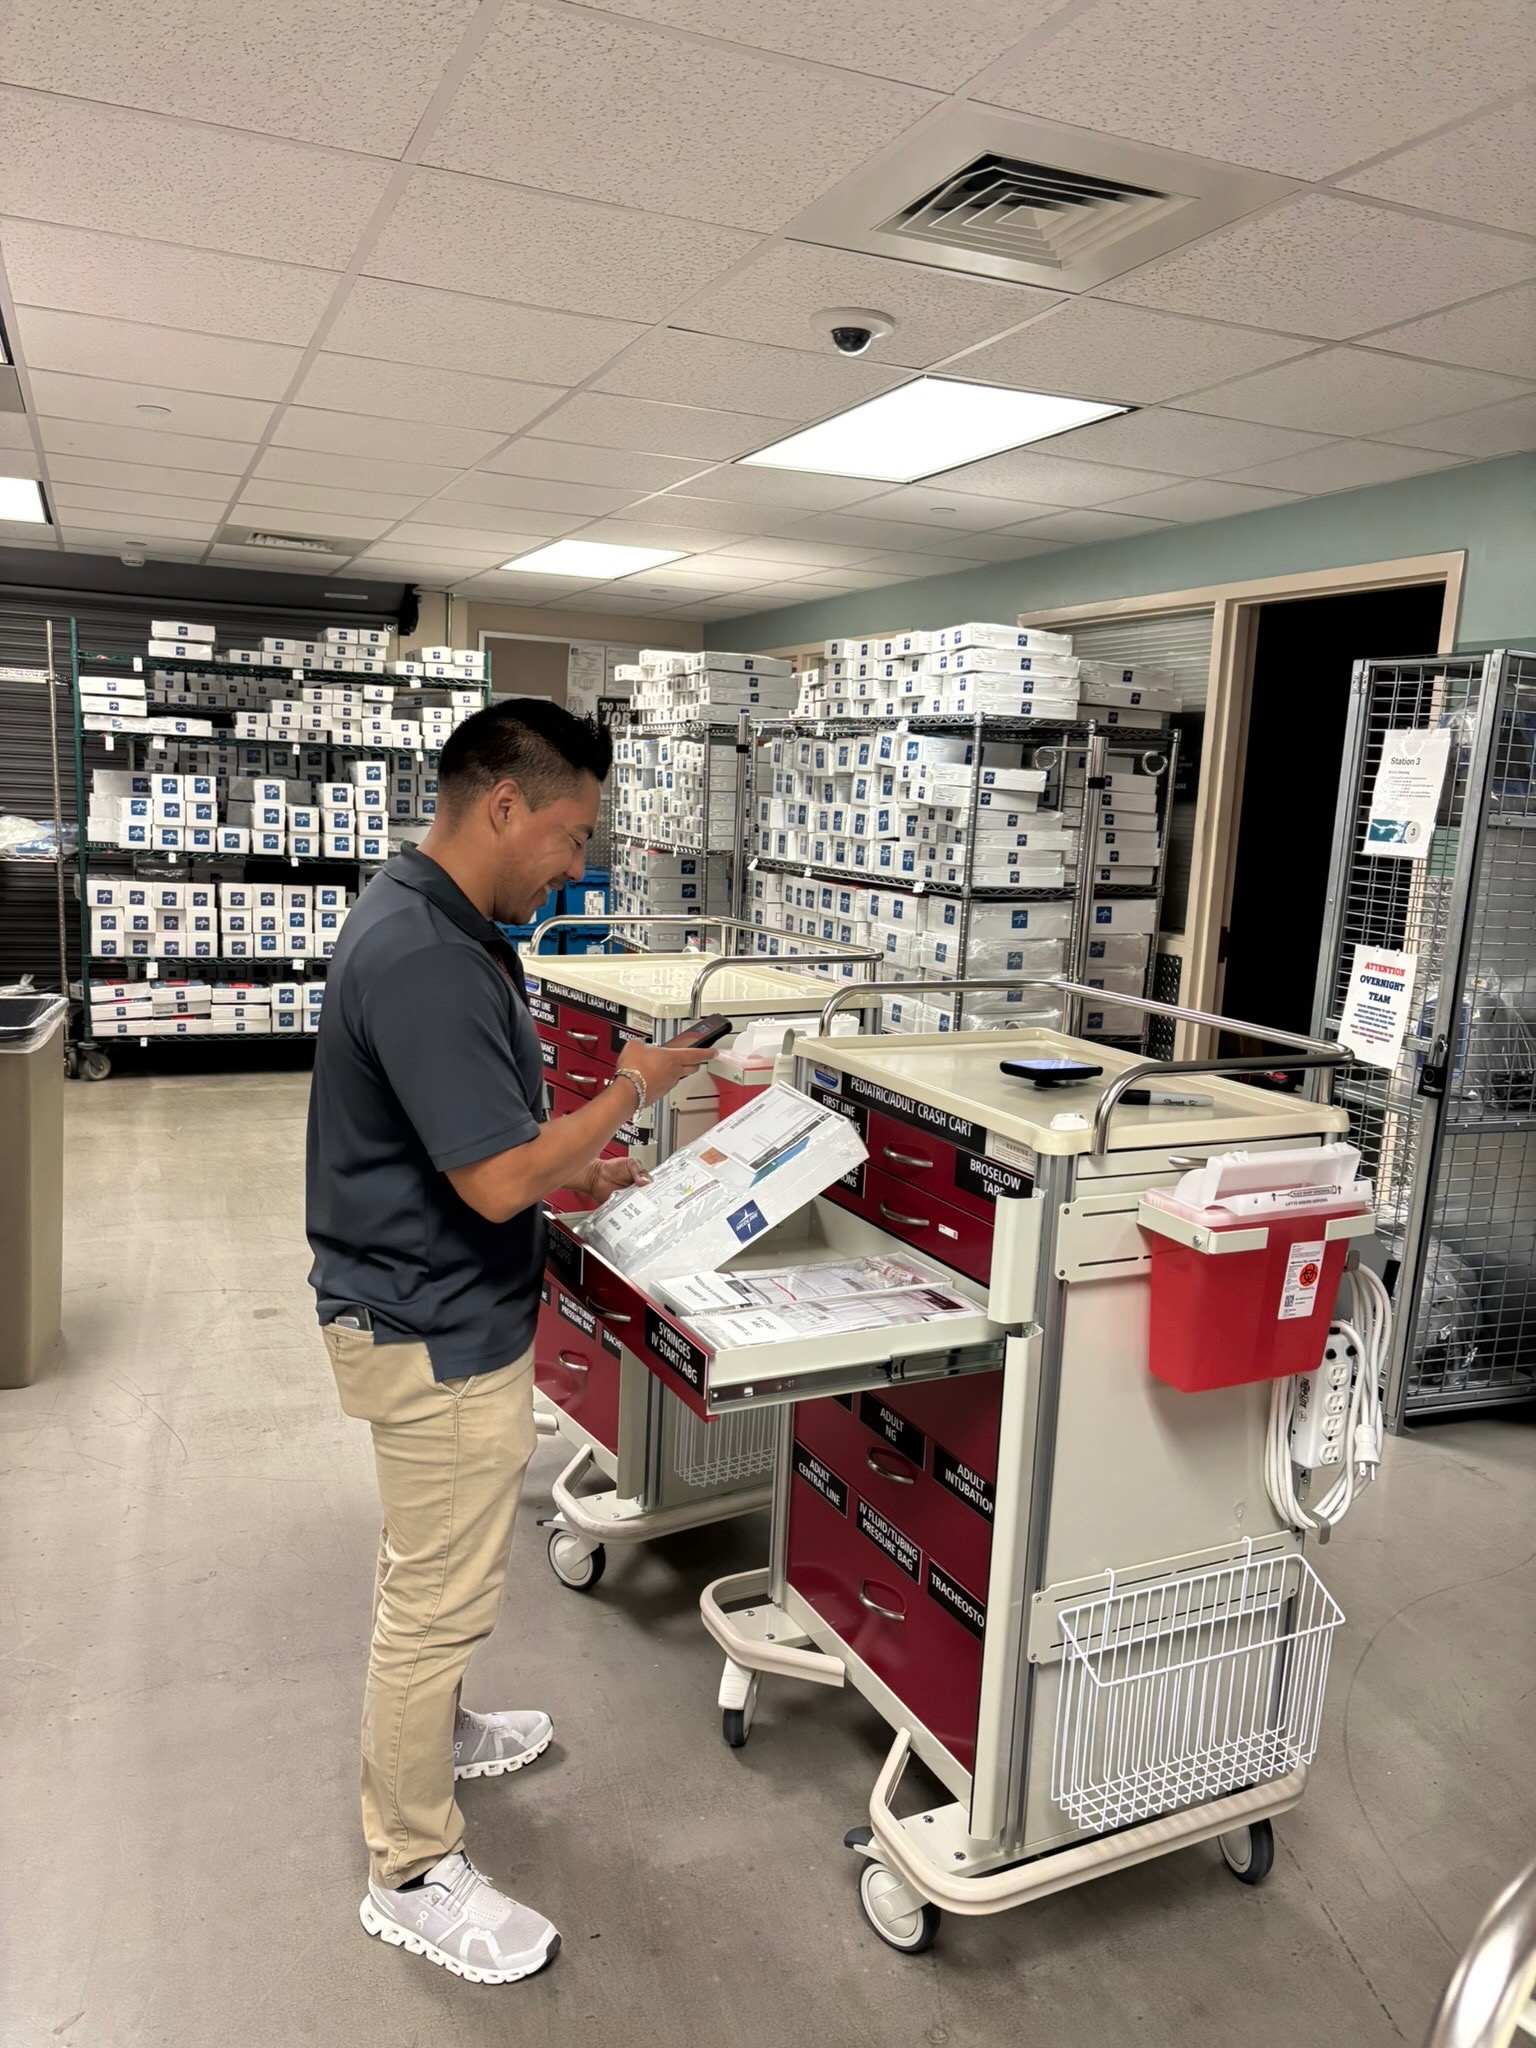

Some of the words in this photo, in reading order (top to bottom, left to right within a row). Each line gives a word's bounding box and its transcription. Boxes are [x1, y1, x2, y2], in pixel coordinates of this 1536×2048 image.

[616, 702, 633, 712] YOU
[1390, 756, 1415, 766] Station
[1416, 757, 1421, 766] 3
[1411, 828, 1416, 836] 3
[1364, 962, 1406, 977] ATTENTION
[1360, 974, 1406, 992] OVERNIGHT
[541, 1001, 551, 1012] LINE
[605, 1000, 620, 1015] CART
[1368, 992, 1391, 1004] TEAM
[529, 1006, 555, 1024] EDICATIONS
[822, 1094, 840, 1111] FIRST
[840, 1100, 856, 1118] LINE
[850, 1077, 916, 1115] PEDIATRIC/ADULT
[917, 1104, 947, 1128] CRASH
[948, 1115, 974, 1138] CART
[969, 1158, 1022, 1191] BROSELOW
[736, 1211, 759, 1231] MEDLINE
[560, 1304, 583, 1328] PRESSURE
[582, 1320, 594, 1334] BAG
[603, 1329, 623, 1351] TRACHE
[658, 1321, 691, 1360] SYRINGES
[651, 1332, 658, 1348] IV
[658, 1339, 698, 1385] START/ABG
[880, 1407, 905, 1433] ADULT
[885, 1425, 897, 1442] NG
[809, 1459, 831, 1482] ADULT
[956, 1463, 987, 1492] ADULT
[798, 1462, 826, 1494] CENTRAL
[826, 1486, 841, 1507] LINE
[859, 1501, 868, 1516] IV
[868, 1507, 919, 1561] FLUID/TUBING
[862, 1518, 896, 1557] PRESSURE
[897, 1549, 914, 1573] BAG
[930, 1572, 985, 1628] TRACHEOSTO
